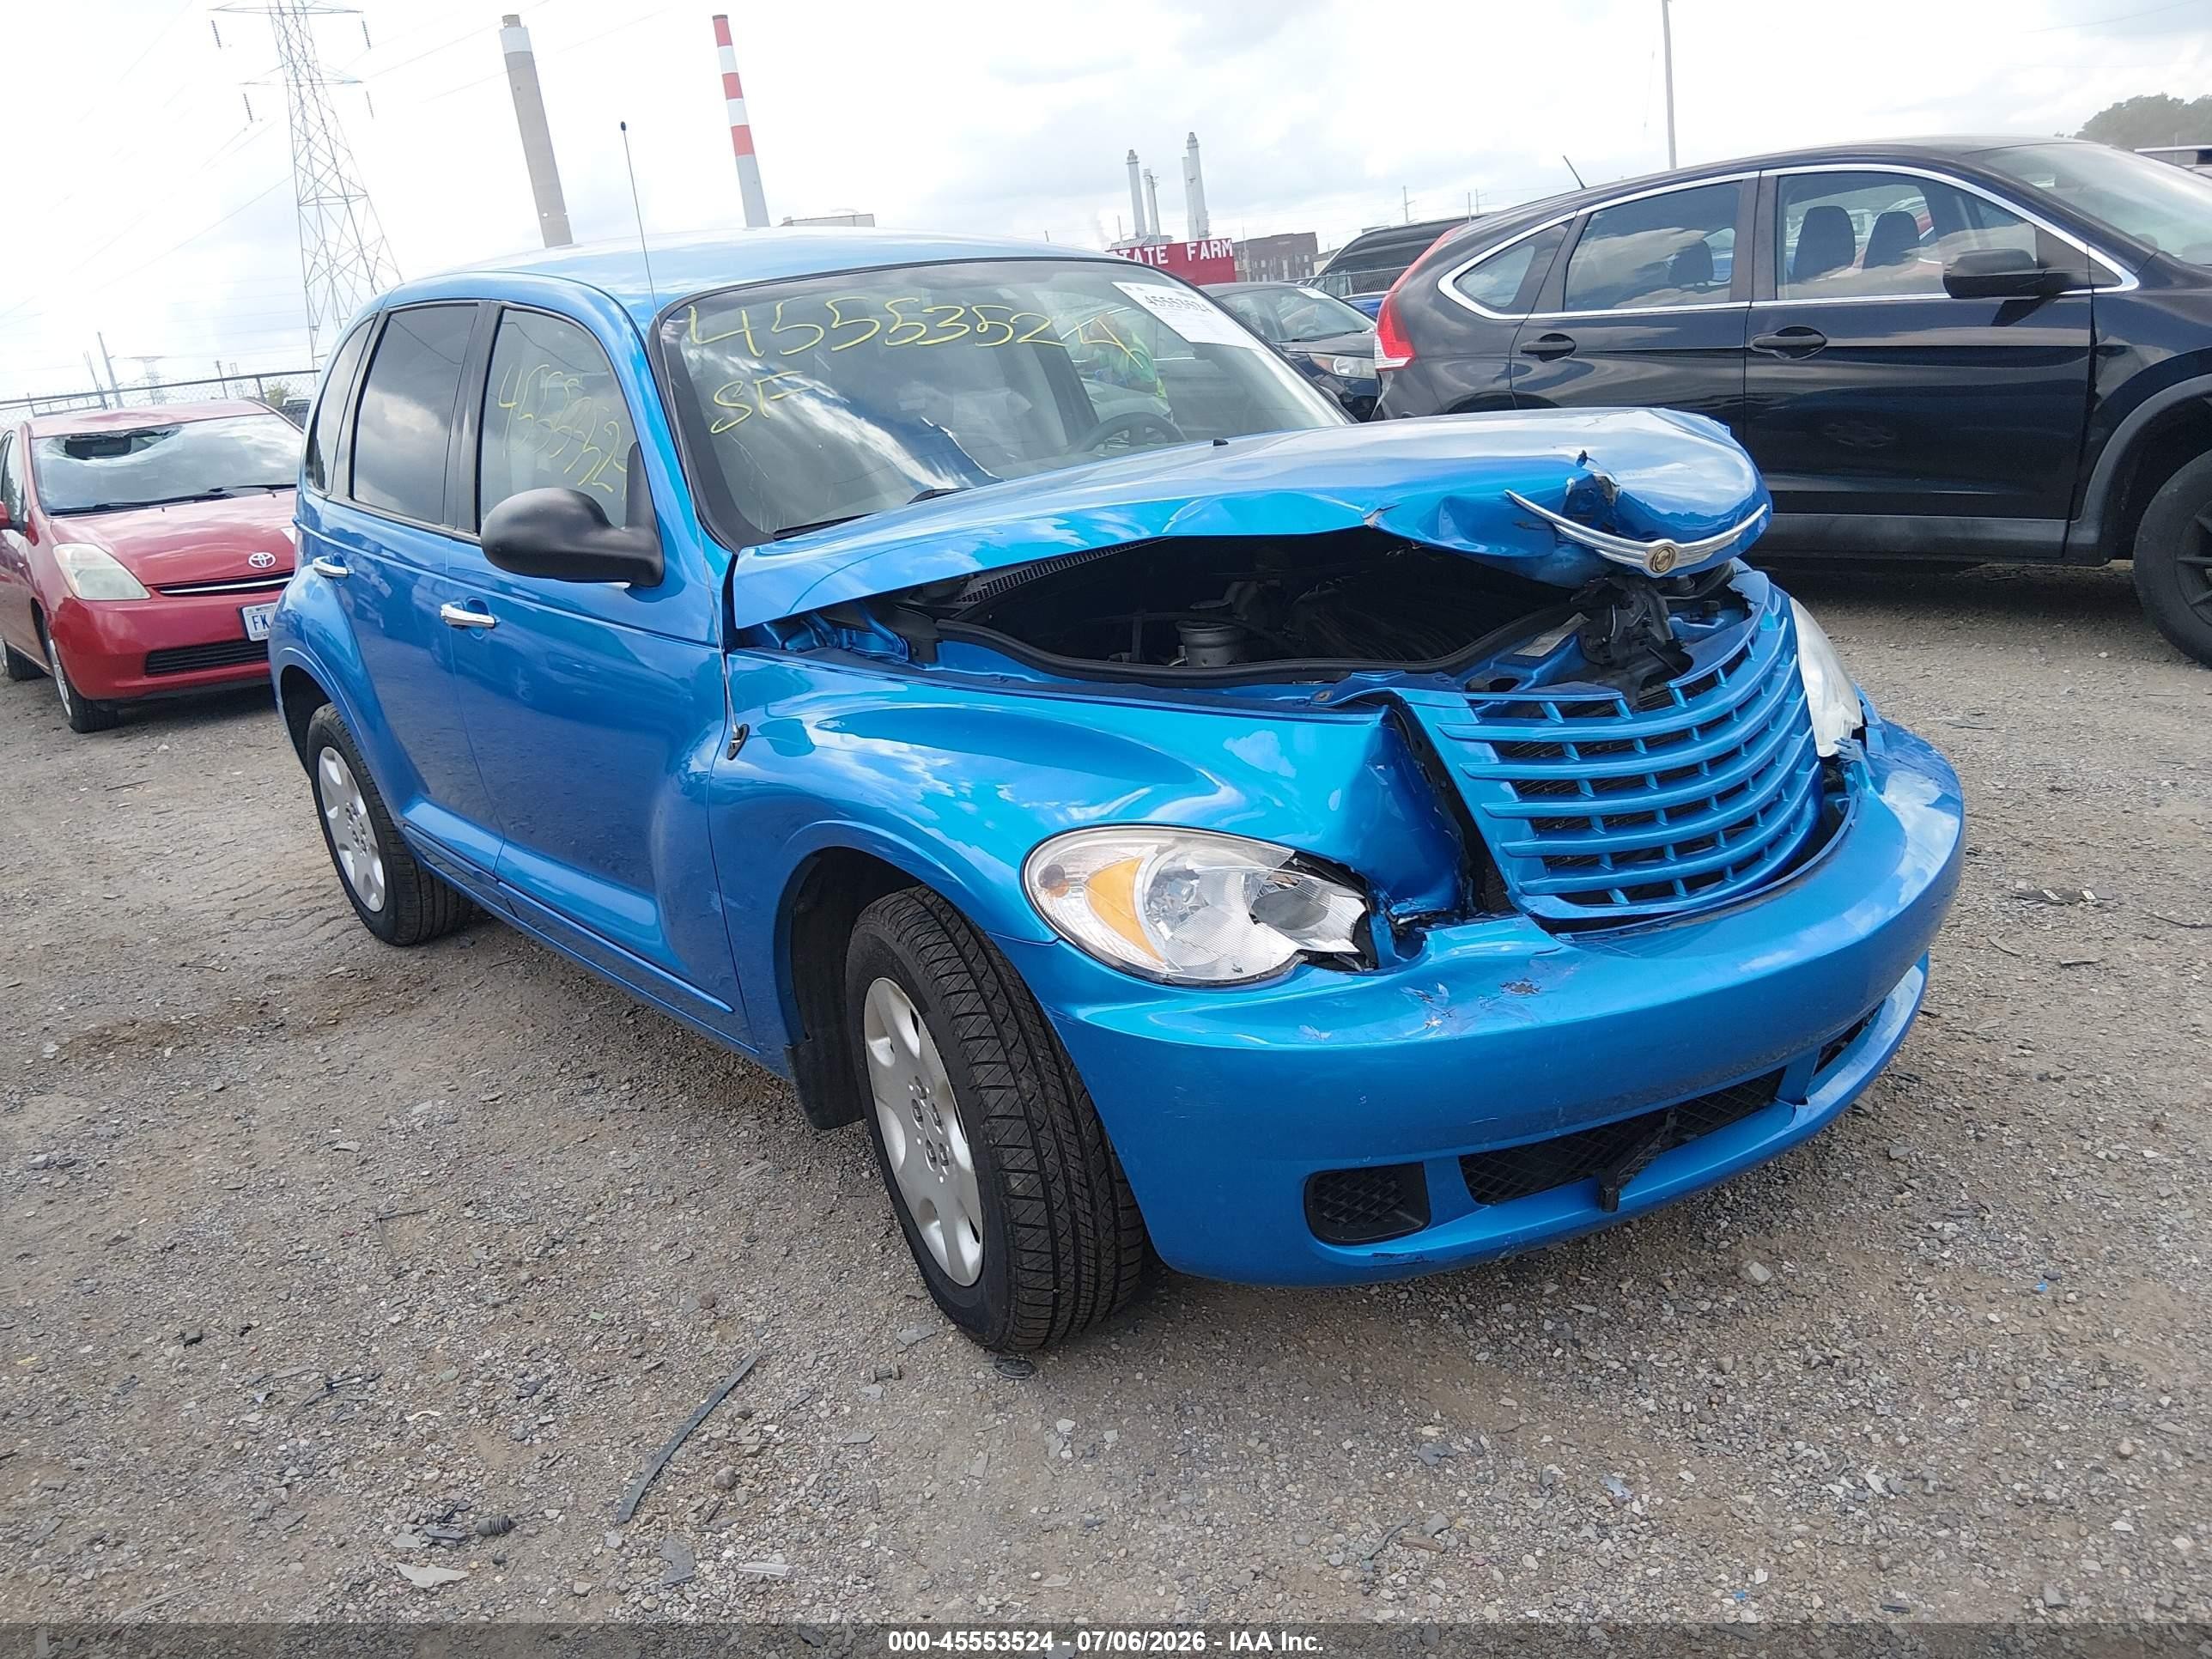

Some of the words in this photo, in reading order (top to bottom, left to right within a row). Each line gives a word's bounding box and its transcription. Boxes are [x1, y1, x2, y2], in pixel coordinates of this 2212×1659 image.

[1187, 239, 1233, 261] FARM
[688, 295, 1144, 369] 45553524
[710, 370, 817, 434] SF
